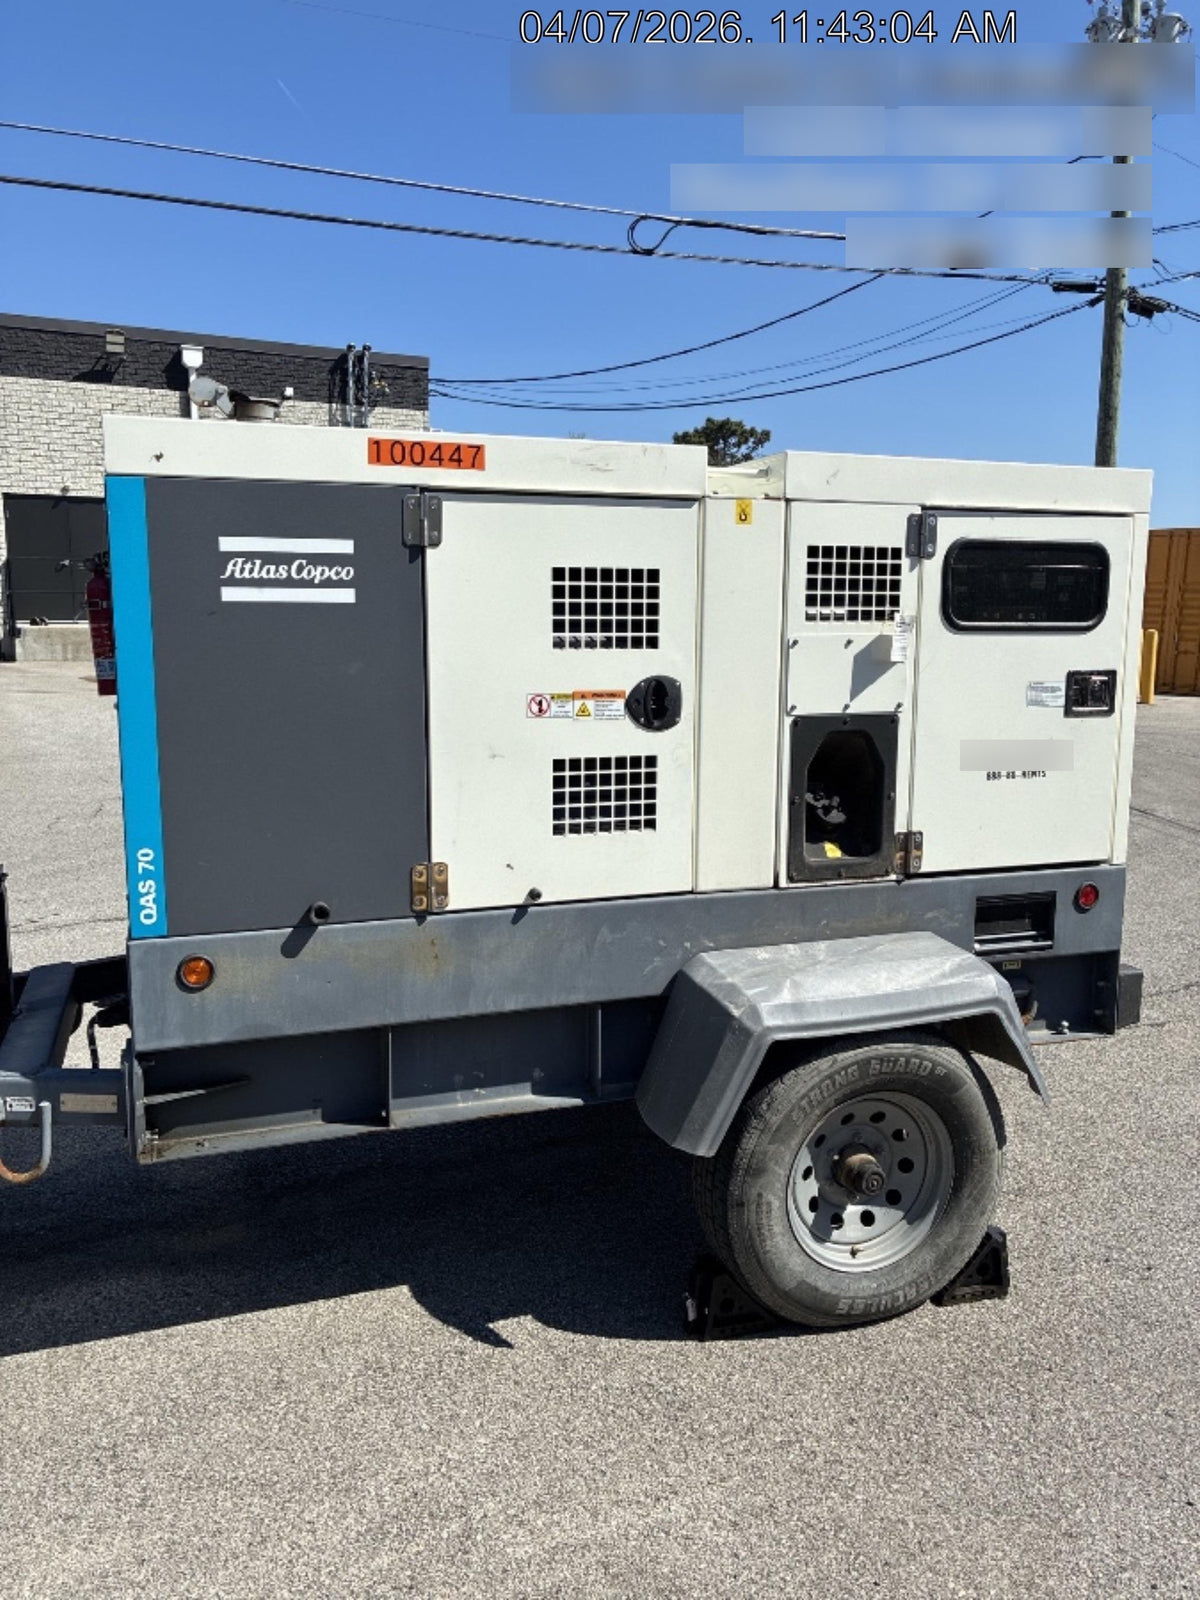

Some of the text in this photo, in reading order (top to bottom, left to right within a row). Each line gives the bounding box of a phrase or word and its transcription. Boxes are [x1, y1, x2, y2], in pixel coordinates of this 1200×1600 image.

[372, 440, 481, 468] 100447
[219, 557, 355, 584] Atlas Copco
[136, 847, 157, 926] QAS 70
[791, 1064, 859, 1124] STRONG
[869, 1057, 932, 1076] GUARD
